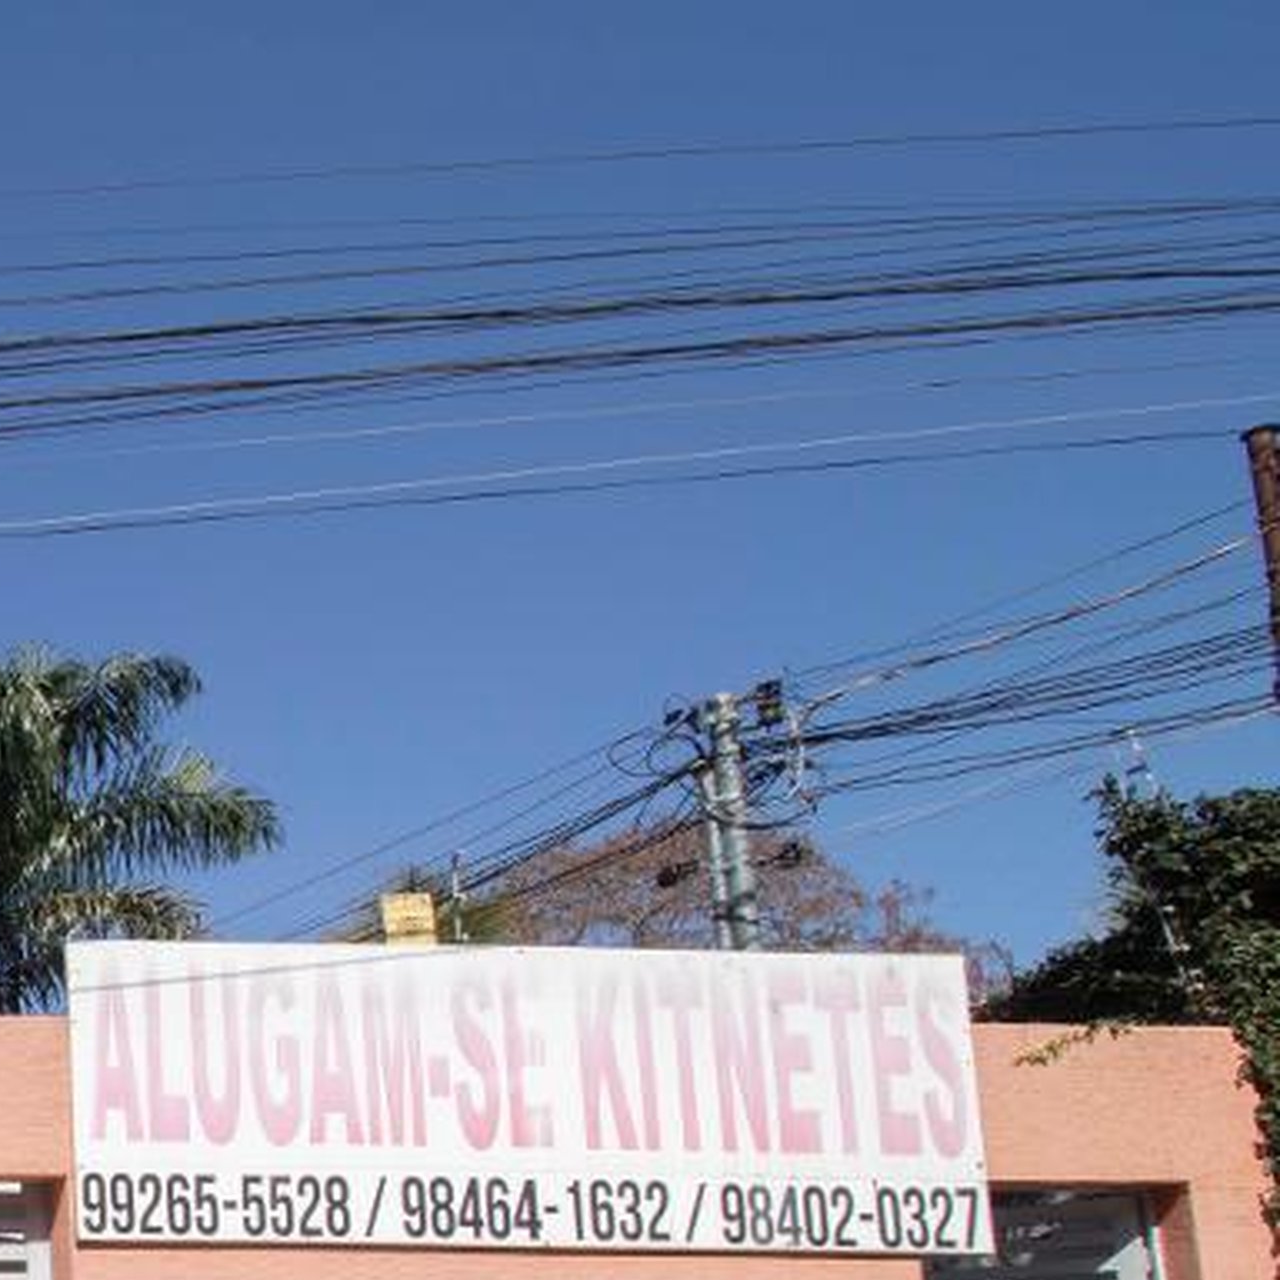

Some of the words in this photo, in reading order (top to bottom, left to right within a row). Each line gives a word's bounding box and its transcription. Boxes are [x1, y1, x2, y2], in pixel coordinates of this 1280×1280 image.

[90, 958, 558, 1151] ALUGAM-SE
[82, 1172, 352, 1237] 99265-5528
[401, 1176, 671, 1242] 98464-1632
[721, 1183, 979, 1249] 98402-0327
